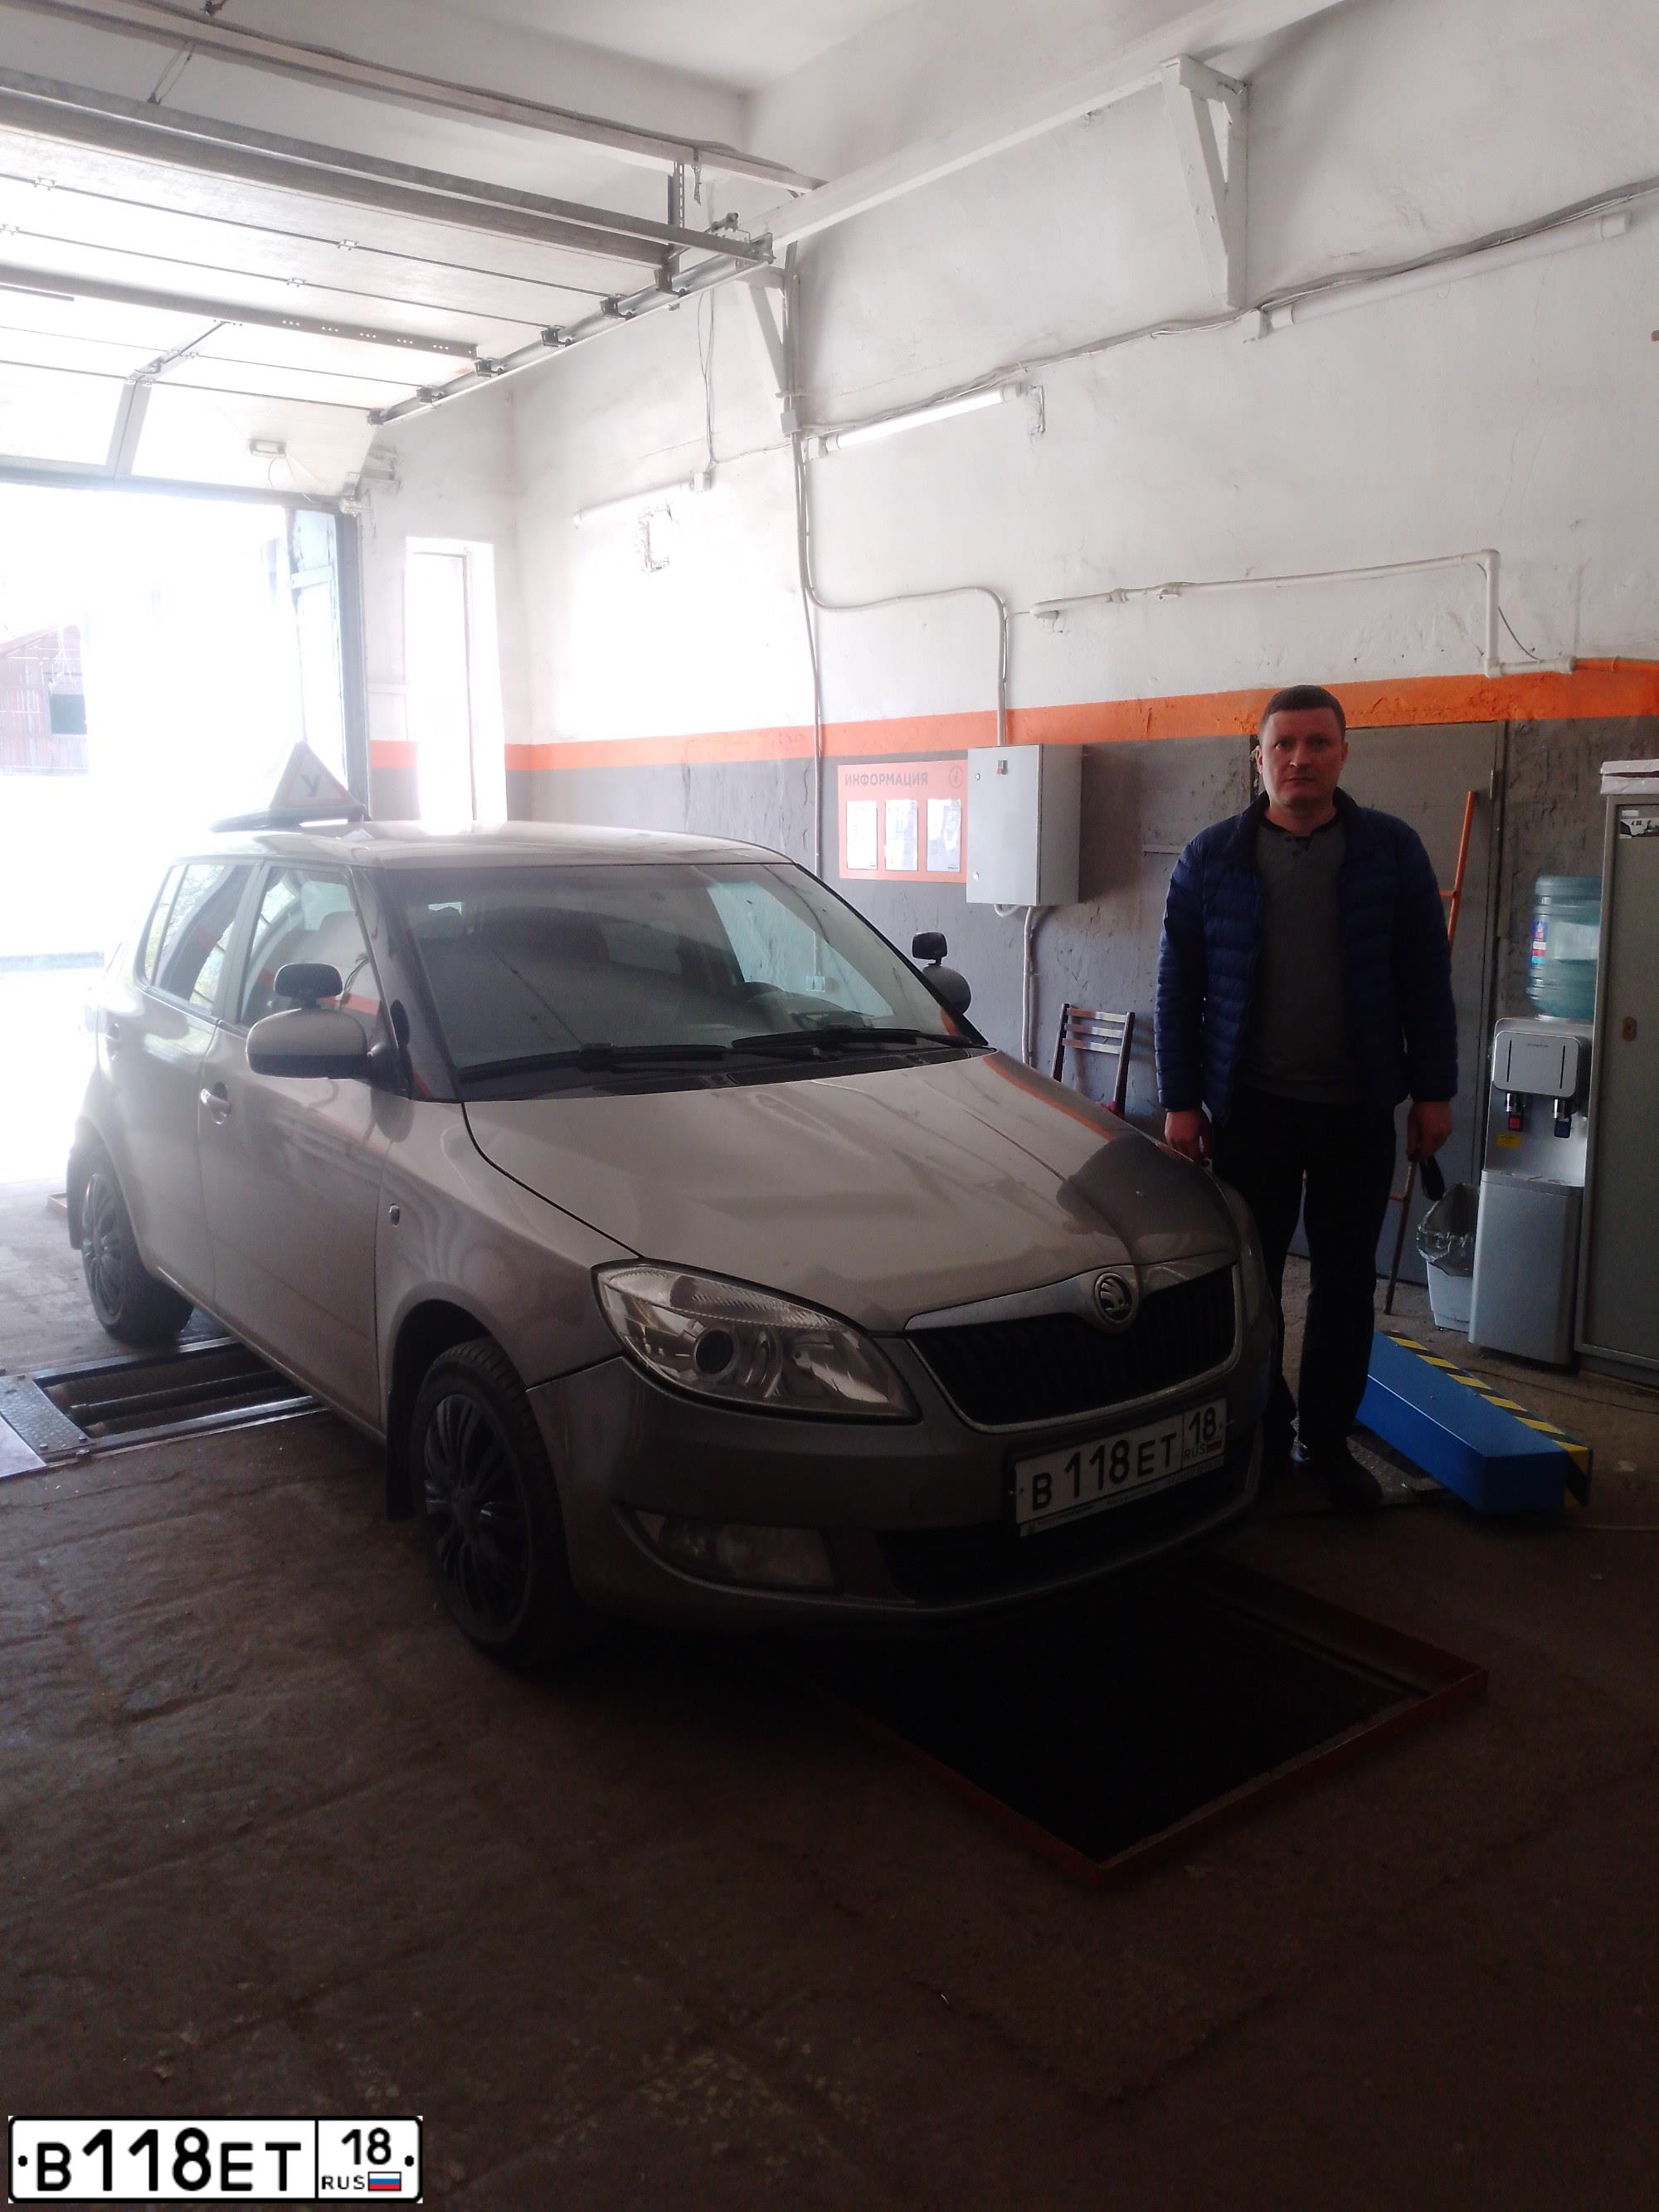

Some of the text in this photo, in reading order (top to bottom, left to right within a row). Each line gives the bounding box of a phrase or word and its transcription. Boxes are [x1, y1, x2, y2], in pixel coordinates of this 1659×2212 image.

[844, 772, 928, 787] ИНФОРМАЦИЯ
[1189, 1406, 1216, 1445] 18
[1184, 1444, 1208, 1460] RUS
